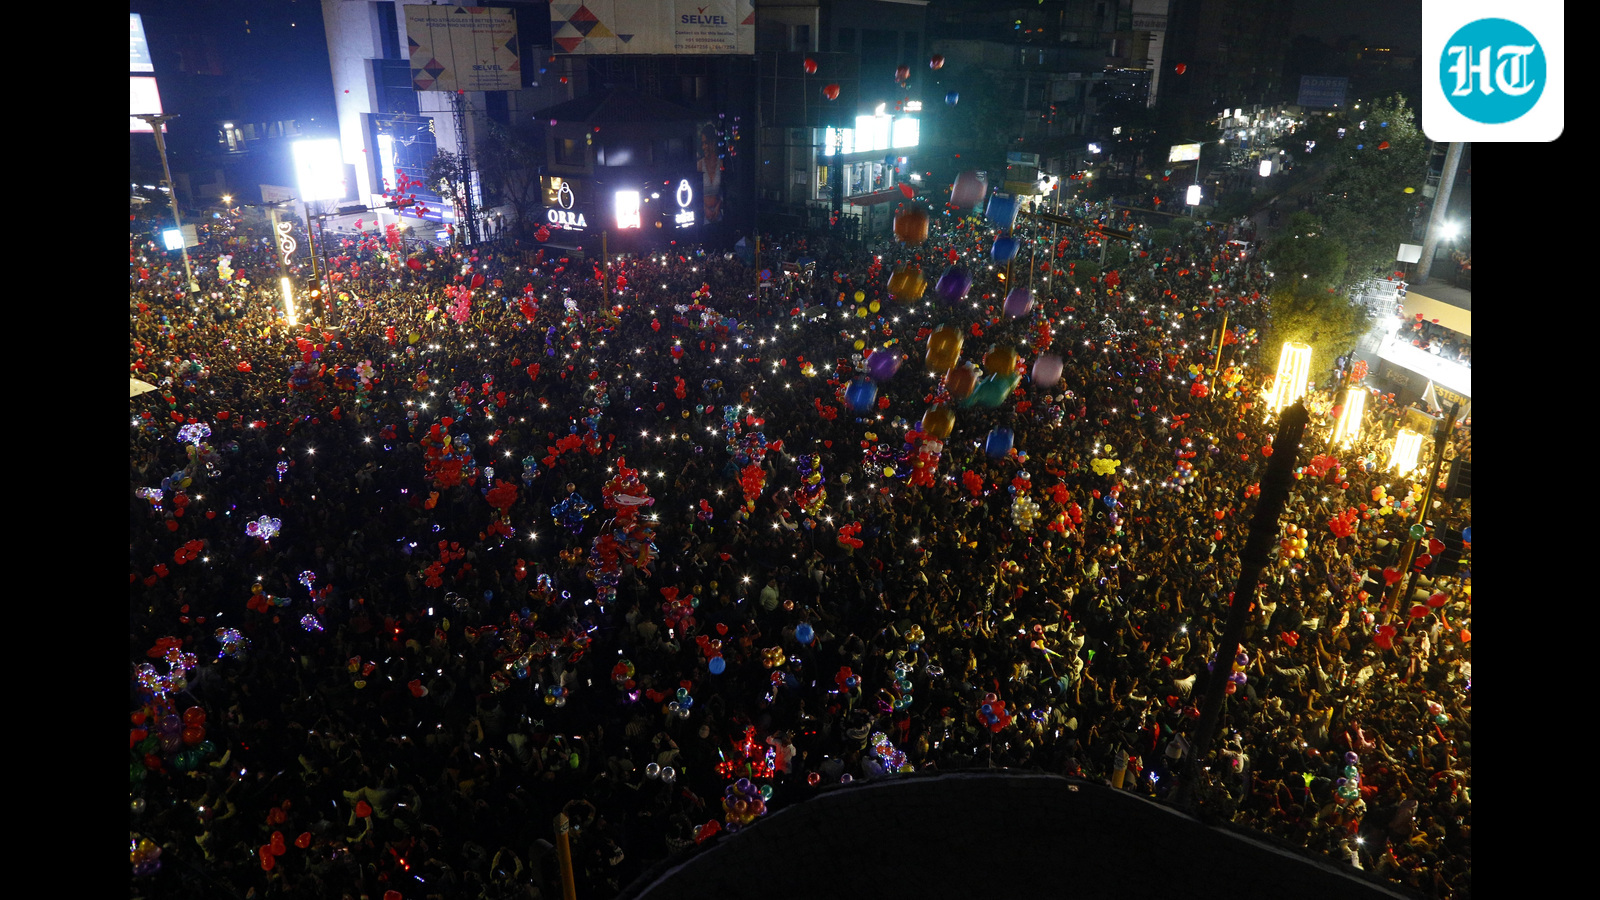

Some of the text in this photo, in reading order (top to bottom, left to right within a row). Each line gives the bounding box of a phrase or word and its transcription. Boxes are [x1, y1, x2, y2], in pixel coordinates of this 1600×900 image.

[682, 15, 727, 24] SELVEL
[548, 209, 588, 227] ORRA
[1428, 383, 1467, 407] ESTERN
